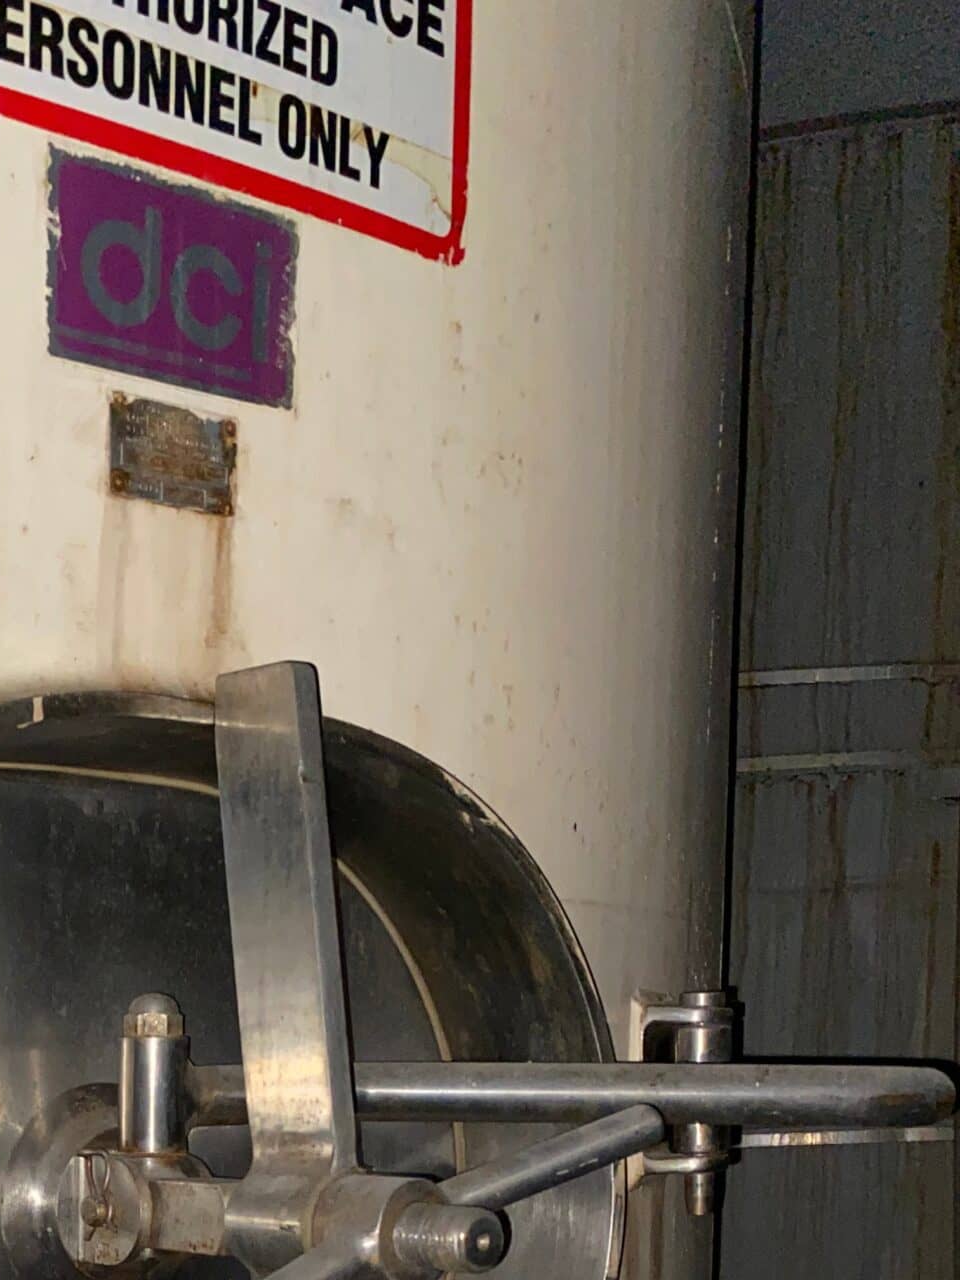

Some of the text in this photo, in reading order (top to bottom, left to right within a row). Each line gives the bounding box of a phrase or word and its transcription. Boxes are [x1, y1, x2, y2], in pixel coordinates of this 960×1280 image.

[112, 0, 338, 86] ORIZED
[341, 0, 444, 57] CE
[278, 94, 390, 190] ONLY
[81, 206, 273, 362] dci
